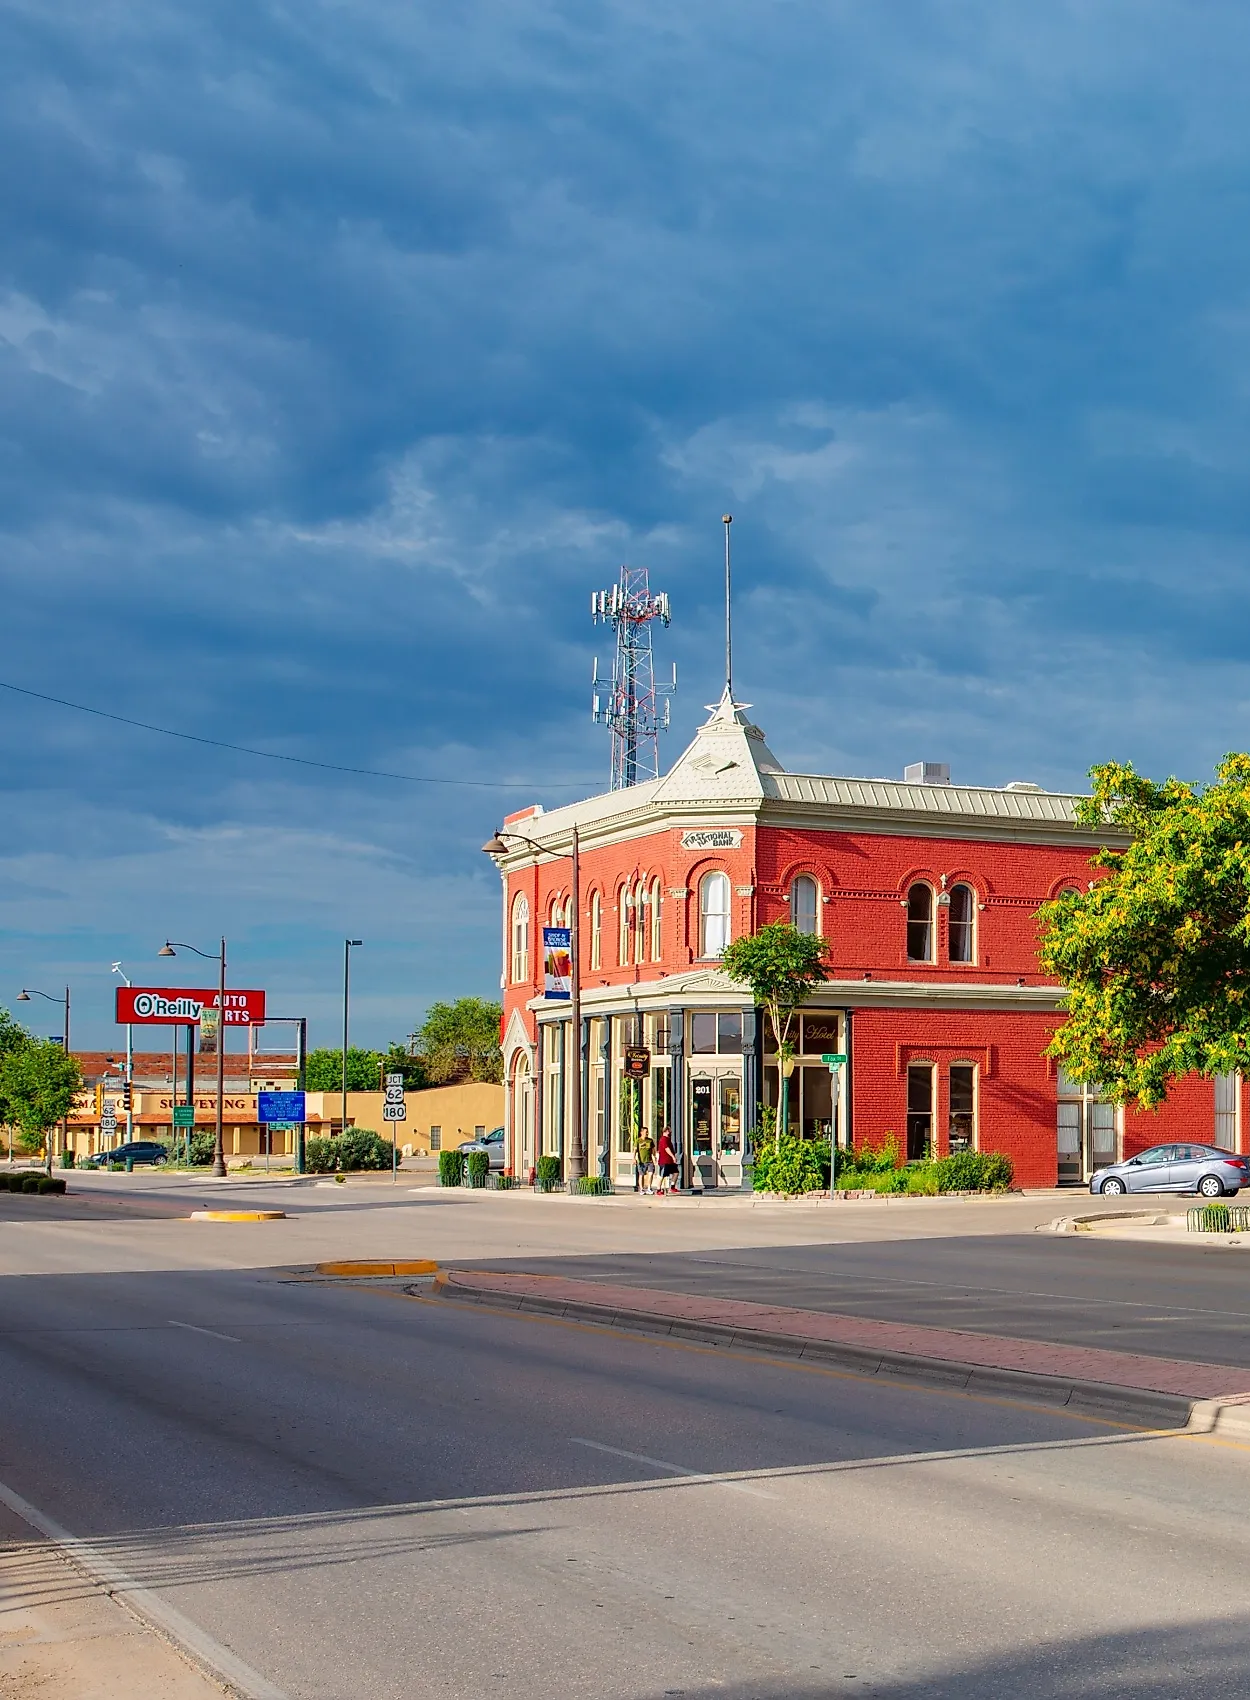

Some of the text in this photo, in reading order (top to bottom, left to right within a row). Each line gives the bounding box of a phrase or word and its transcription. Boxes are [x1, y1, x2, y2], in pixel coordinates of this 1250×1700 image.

[684, 832, 706, 848] FIRST
[697, 831, 731, 848] NATIONAL
[712, 836, 734, 847] BANK
[135, 993, 203, 1019] O'Reilly
[213, 994, 247, 1007] AUTO
[224, 1010, 250, 1022] RTS
[804, 1024, 836, 1040] Hotel
[388, 1075, 402, 1084] JCT
[387, 1089, 402, 1099] 62
[695, 1086, 710, 1094] 201
[104, 1107, 114, 1115] 62
[385, 1107, 404, 1118] 180
[102, 1119, 116, 1127] 180
